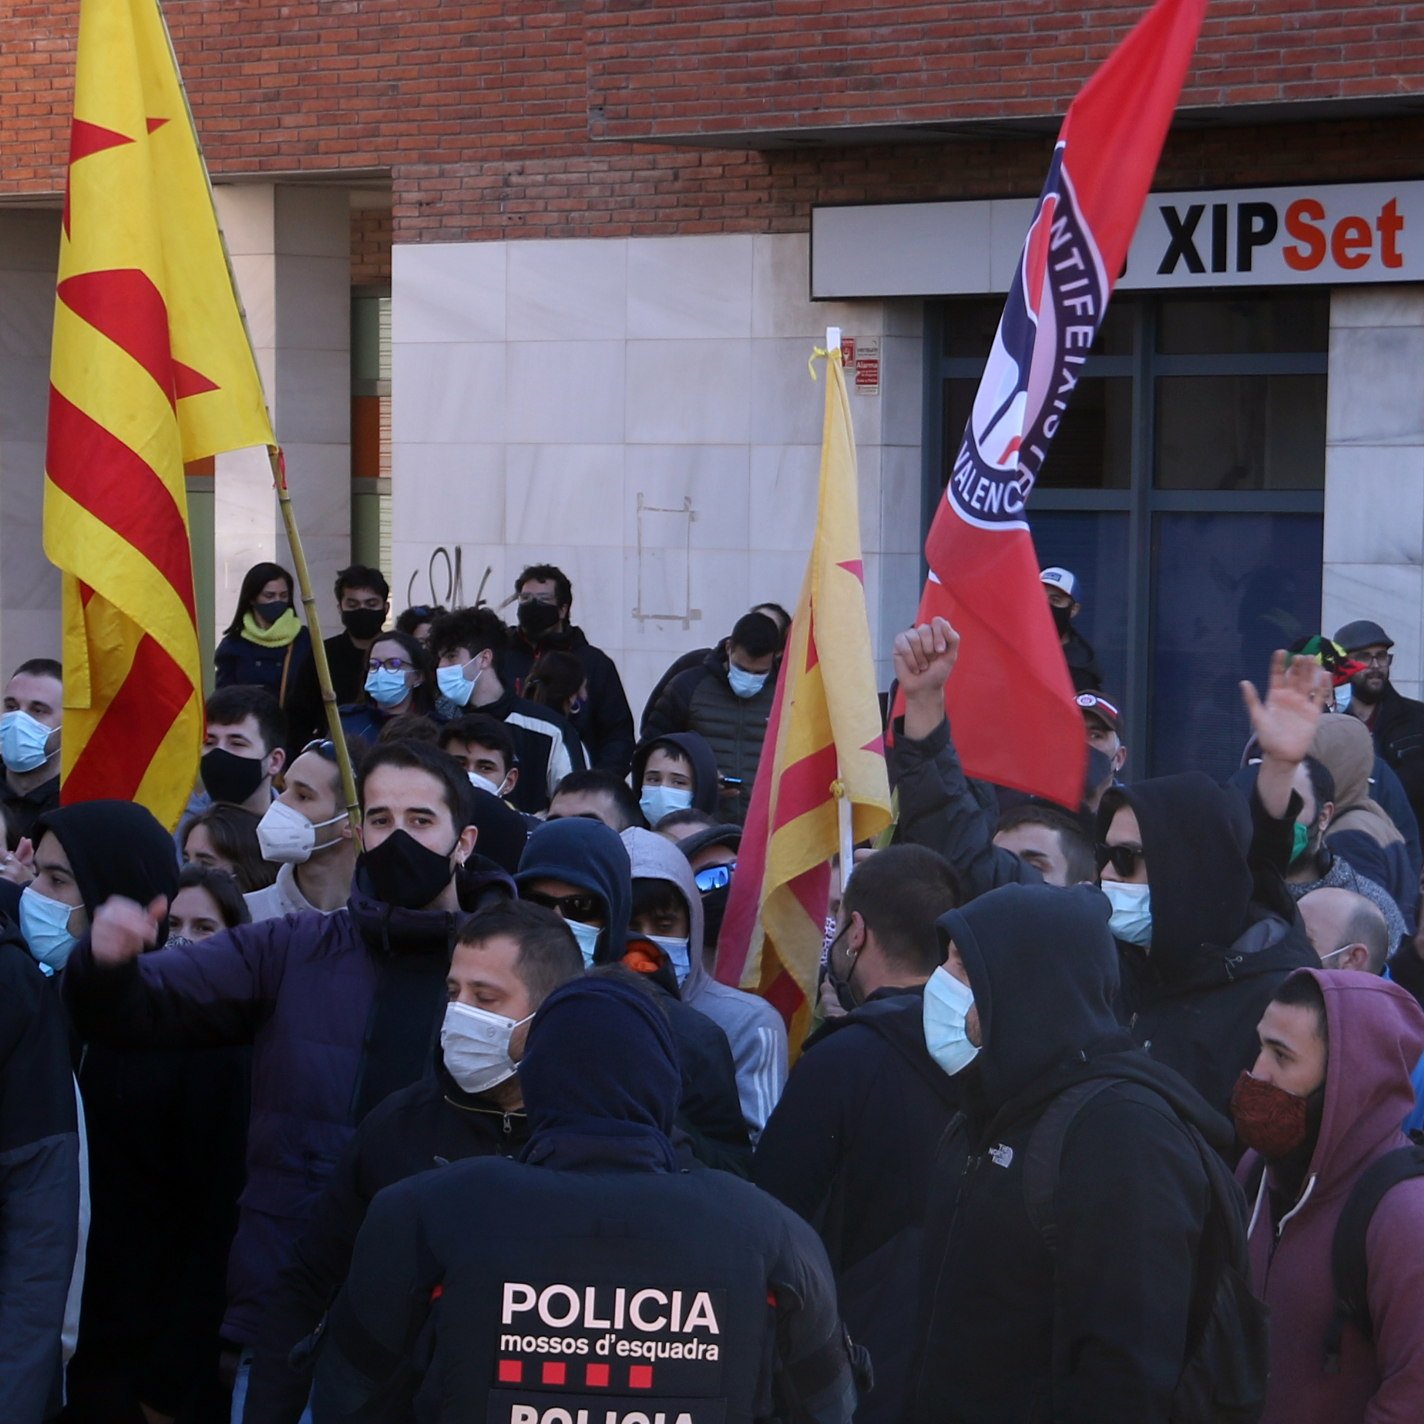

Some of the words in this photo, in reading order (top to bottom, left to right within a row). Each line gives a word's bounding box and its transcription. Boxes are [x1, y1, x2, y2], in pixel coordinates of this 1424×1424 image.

[1156, 197, 1404, 275] XIPSet
[952, 441, 1024, 514] VALENC
[501, 1282, 720, 1335] POLICIA
[500, 1333, 589, 1355] mossos
[595, 1333, 719, 1362] d'esquadra
